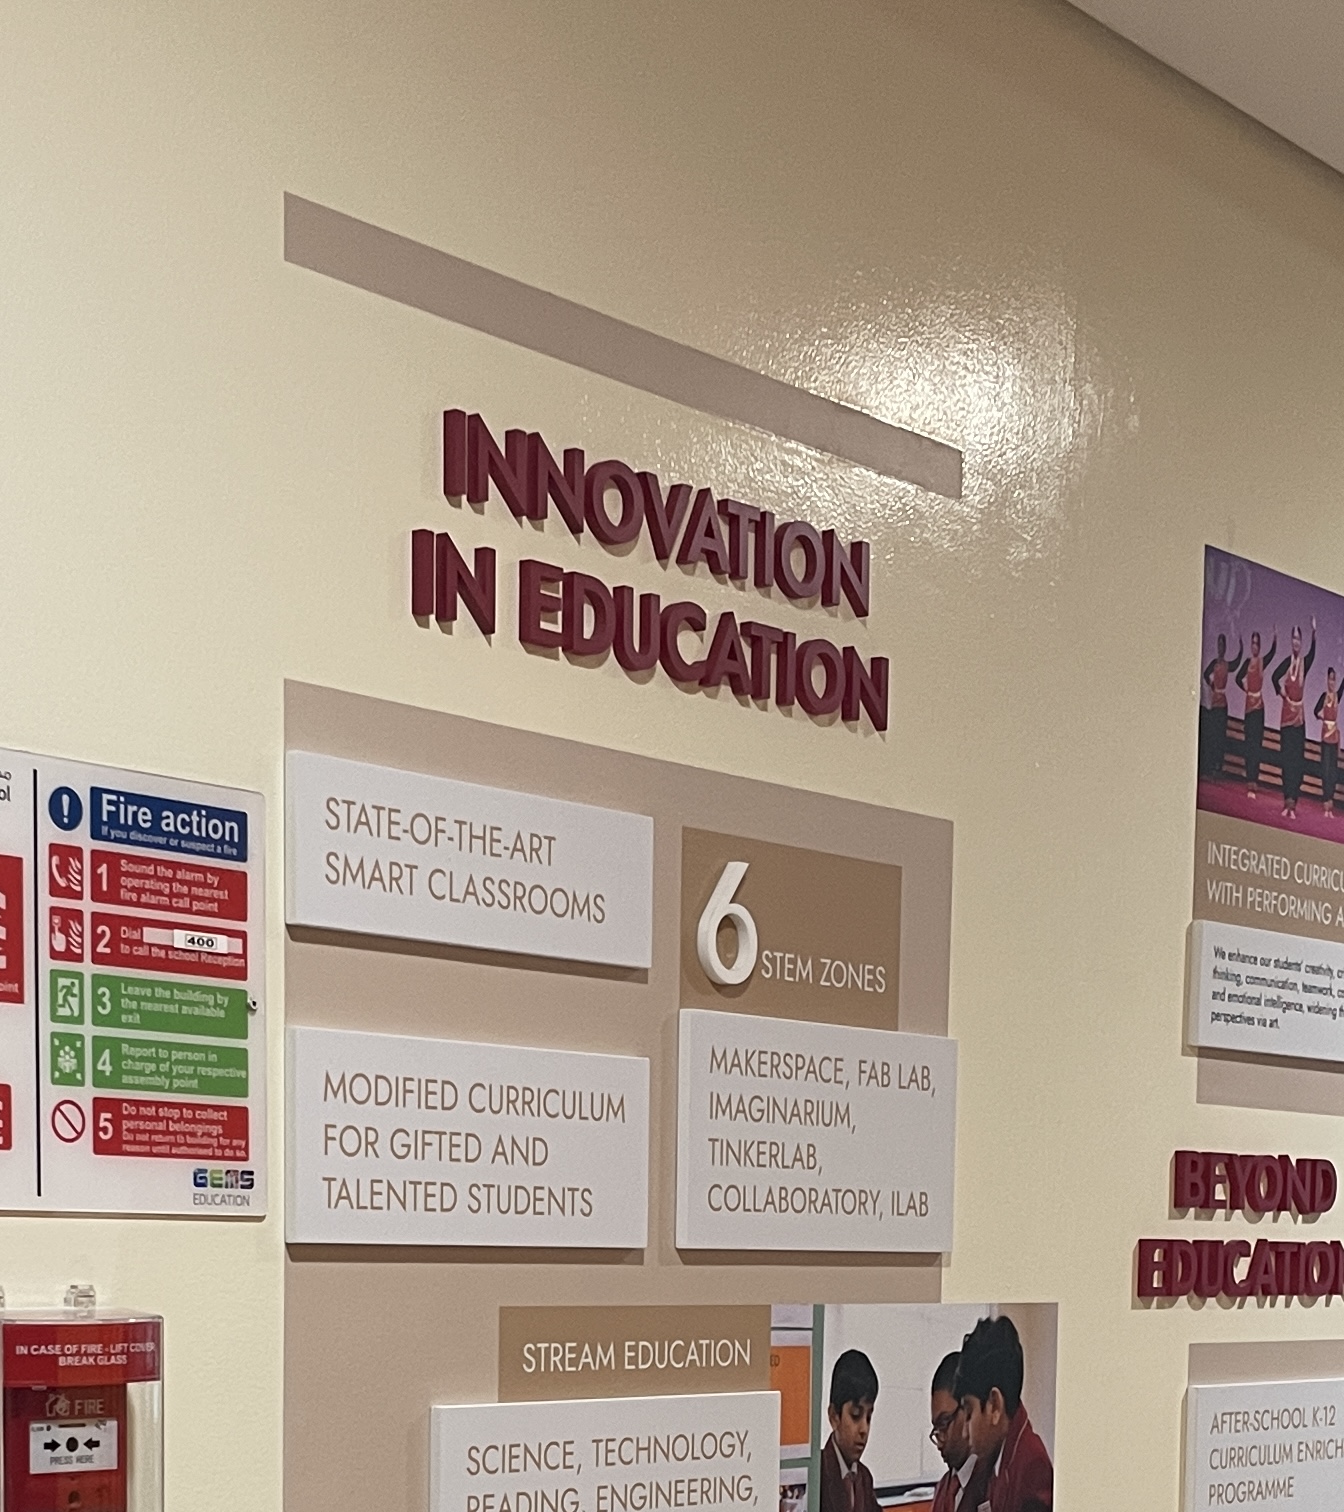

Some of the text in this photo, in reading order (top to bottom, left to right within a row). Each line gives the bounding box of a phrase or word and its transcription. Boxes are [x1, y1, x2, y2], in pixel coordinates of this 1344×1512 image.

[442, 408, 870, 618] INNOVATION
[411, 528, 889, 732] IN EDUCATION
[101, 792, 239, 843] Fire action
[324, 796, 557, 867] STATE-OF-THE-ART
[97, 863, 108, 892] 1
[1207, 840, 1290, 880] INTEGRATED
[324, 850, 605, 924] SMART CLASSROOMS
[1206, 878, 1243, 908] WITH
[1246, 886, 1332, 925] PERFORMING
[96, 924, 112, 954] 2
[187, 936, 215, 948] 400
[697, 860, 886, 993] 6 STEM ZONES
[97, 986, 112, 1015] 3
[96, 1048, 113, 1077] 4
[709, 1044, 936, 1098] MAKERSPACE, FAB LAB,
[323, 1069, 626, 1124] MODIFIED CURRICULUM
[709, 1090, 856, 1134] IMAGINARIUM,
[98, 1112, 114, 1140] 5
[323, 1123, 548, 1167] FOR GIFTED AND
[707, 1137, 822, 1176] TINKERLAB,
[192, 1167, 255, 1190] GEMS
[321, 1176, 593, 1218] TALENTED STUDENTS
[1173, 1149, 1338, 1215] BEYOND
[192, 1192, 250, 1207] EDUCATION
[707, 1182, 929, 1220] COLLABORATORY, ILAB
[58, 1354, 127, 1366] BREAK GLASS
[522, 1338, 750, 1373] STREAM EDUCATION
[74, 1398, 104, 1416] FIRE
[1209, 1404, 1336, 1435] AFTER-SCHOOL K-12
[465, 1429, 751, 1476] SCIENCE, TECHNOLOGY,
[1208, 1442, 1293, 1470] CURRICULUM
[1208, 1475, 1295, 1506] PROGRAMME
